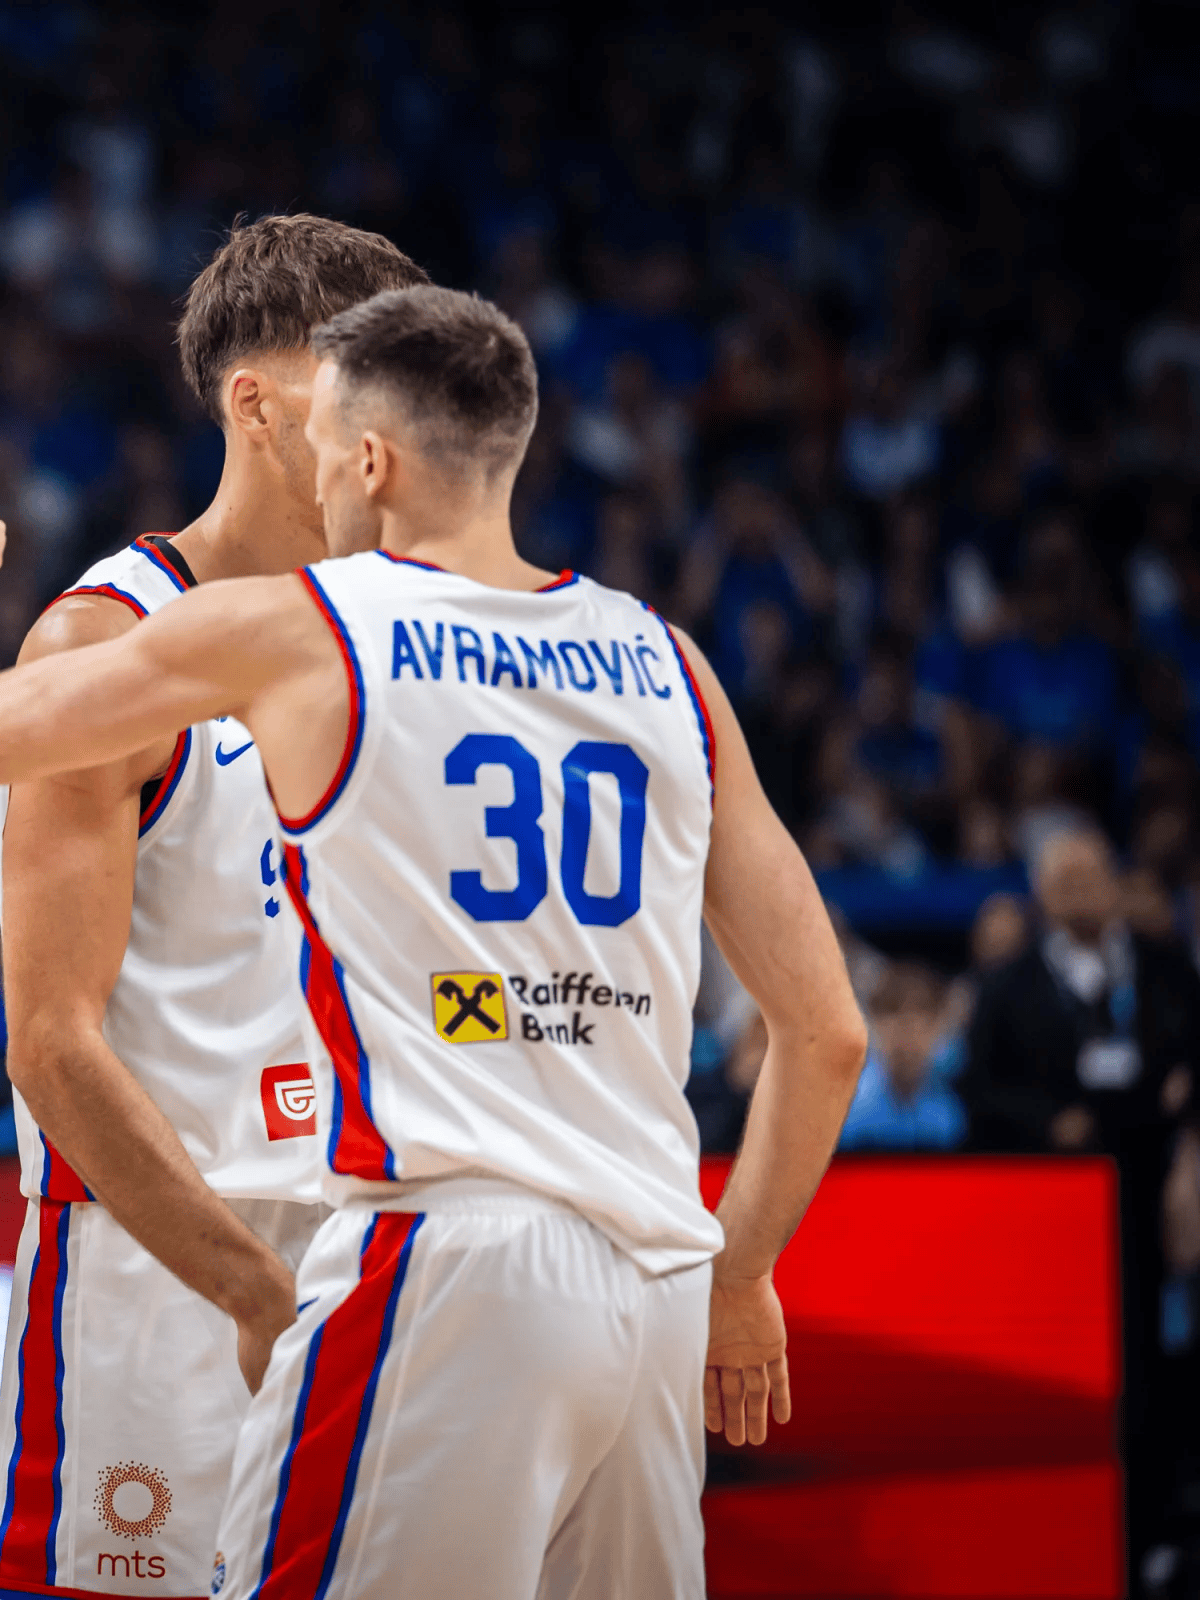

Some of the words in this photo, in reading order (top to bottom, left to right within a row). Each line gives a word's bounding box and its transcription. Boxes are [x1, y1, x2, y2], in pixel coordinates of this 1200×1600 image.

[391, 619, 672, 700] AVRAMOVIĆ
[444, 732, 650, 928] 30
[508, 971, 651, 1016] Raiffen
[97, 1549, 166, 1579] mts
